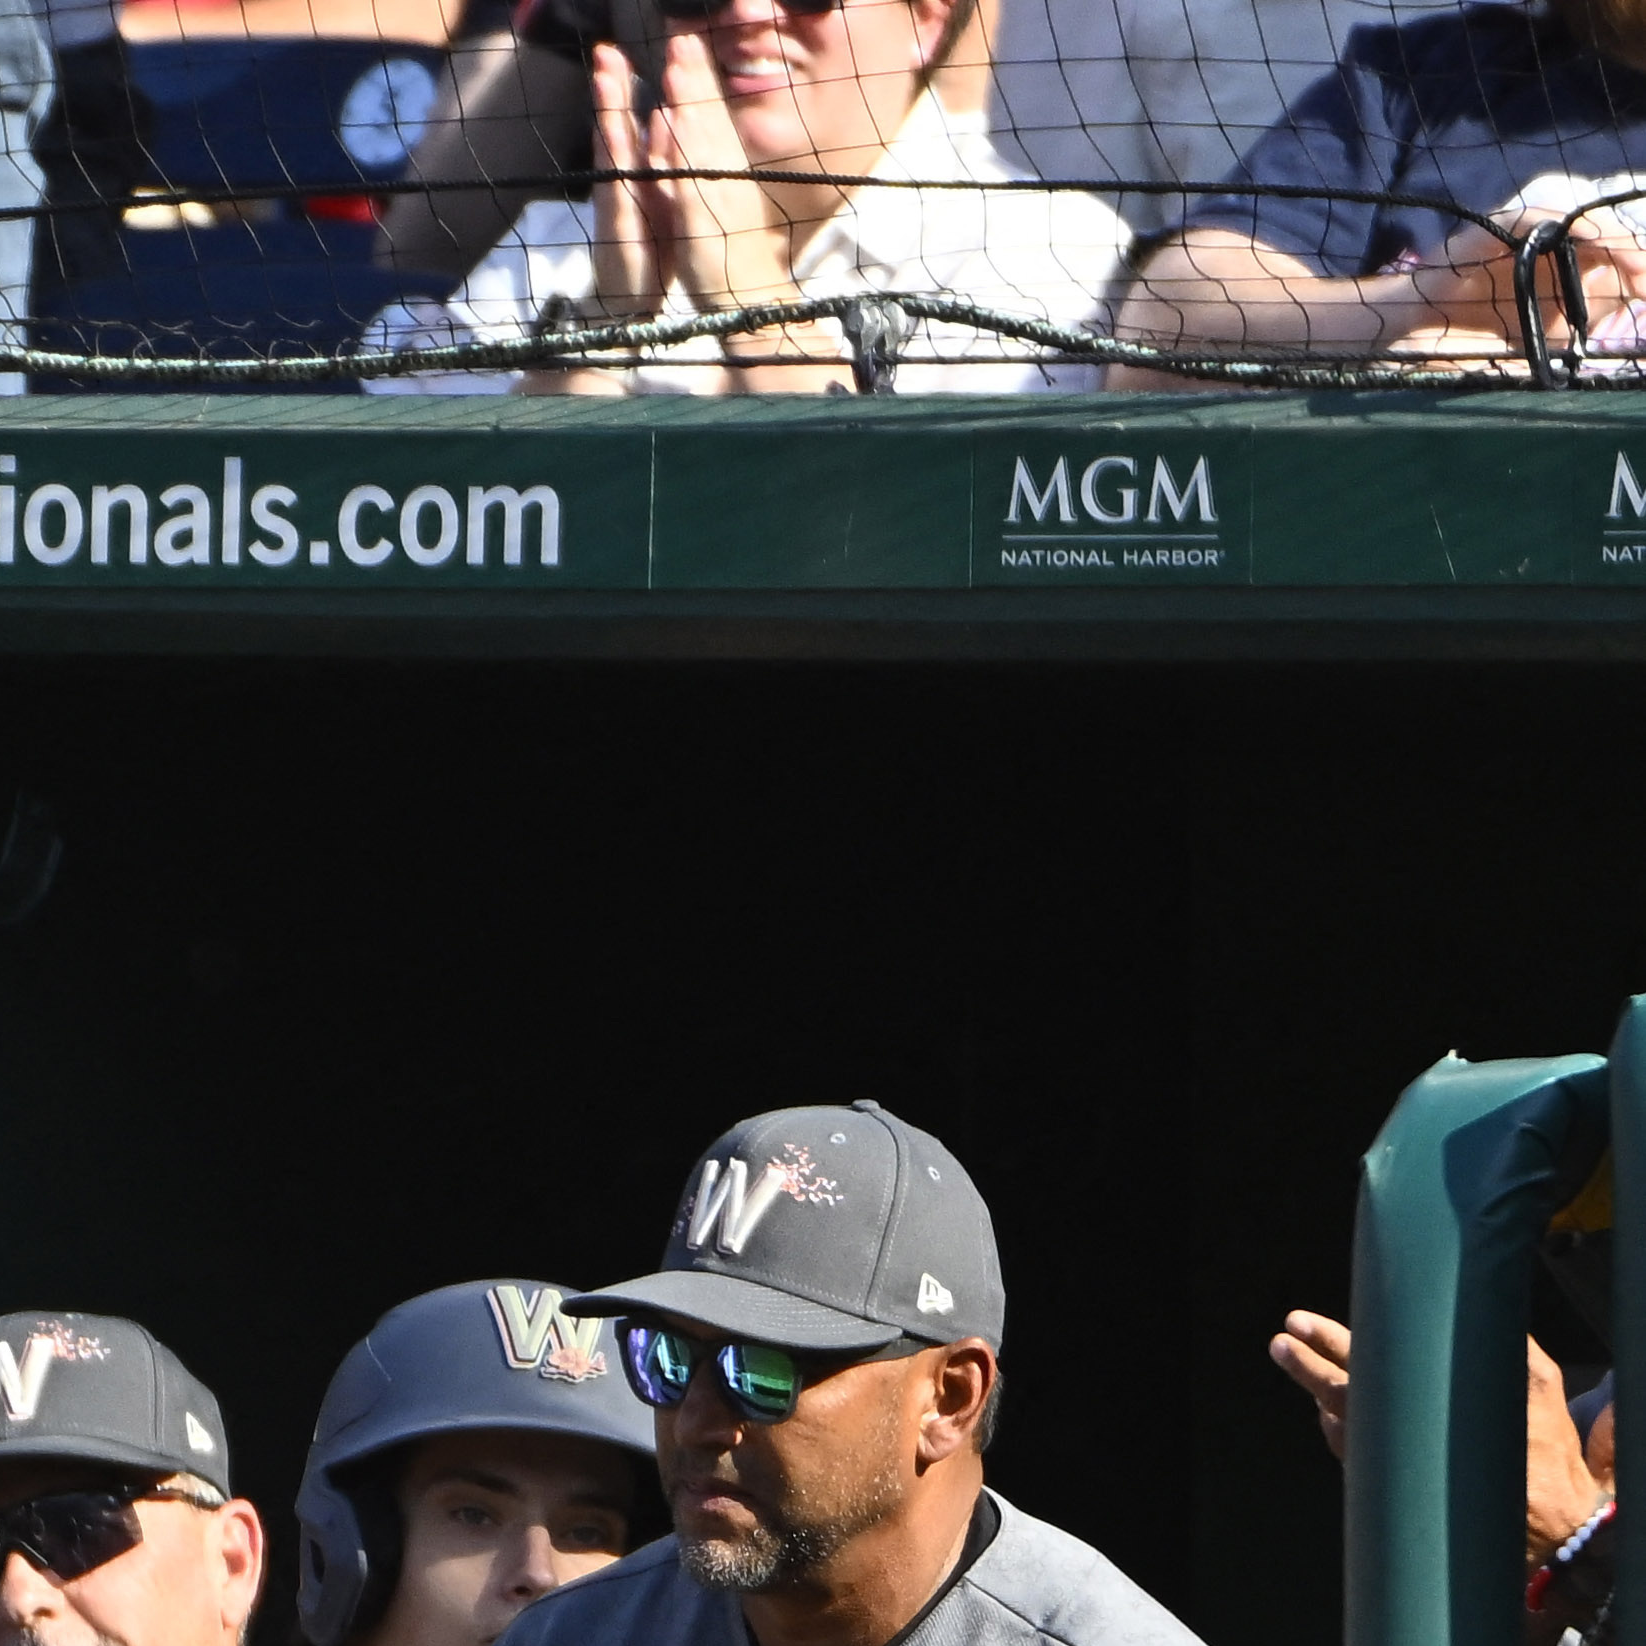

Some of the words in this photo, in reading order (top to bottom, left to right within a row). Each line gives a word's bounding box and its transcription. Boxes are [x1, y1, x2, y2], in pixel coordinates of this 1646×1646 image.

[1003, 454, 1219, 522] MGM
[1000, 549, 1115, 567] NATIONAL
[1122, 549, 1219, 567] HARBOR
[687, 1156, 787, 1255] W
[485, 1285, 604, 1370] W
